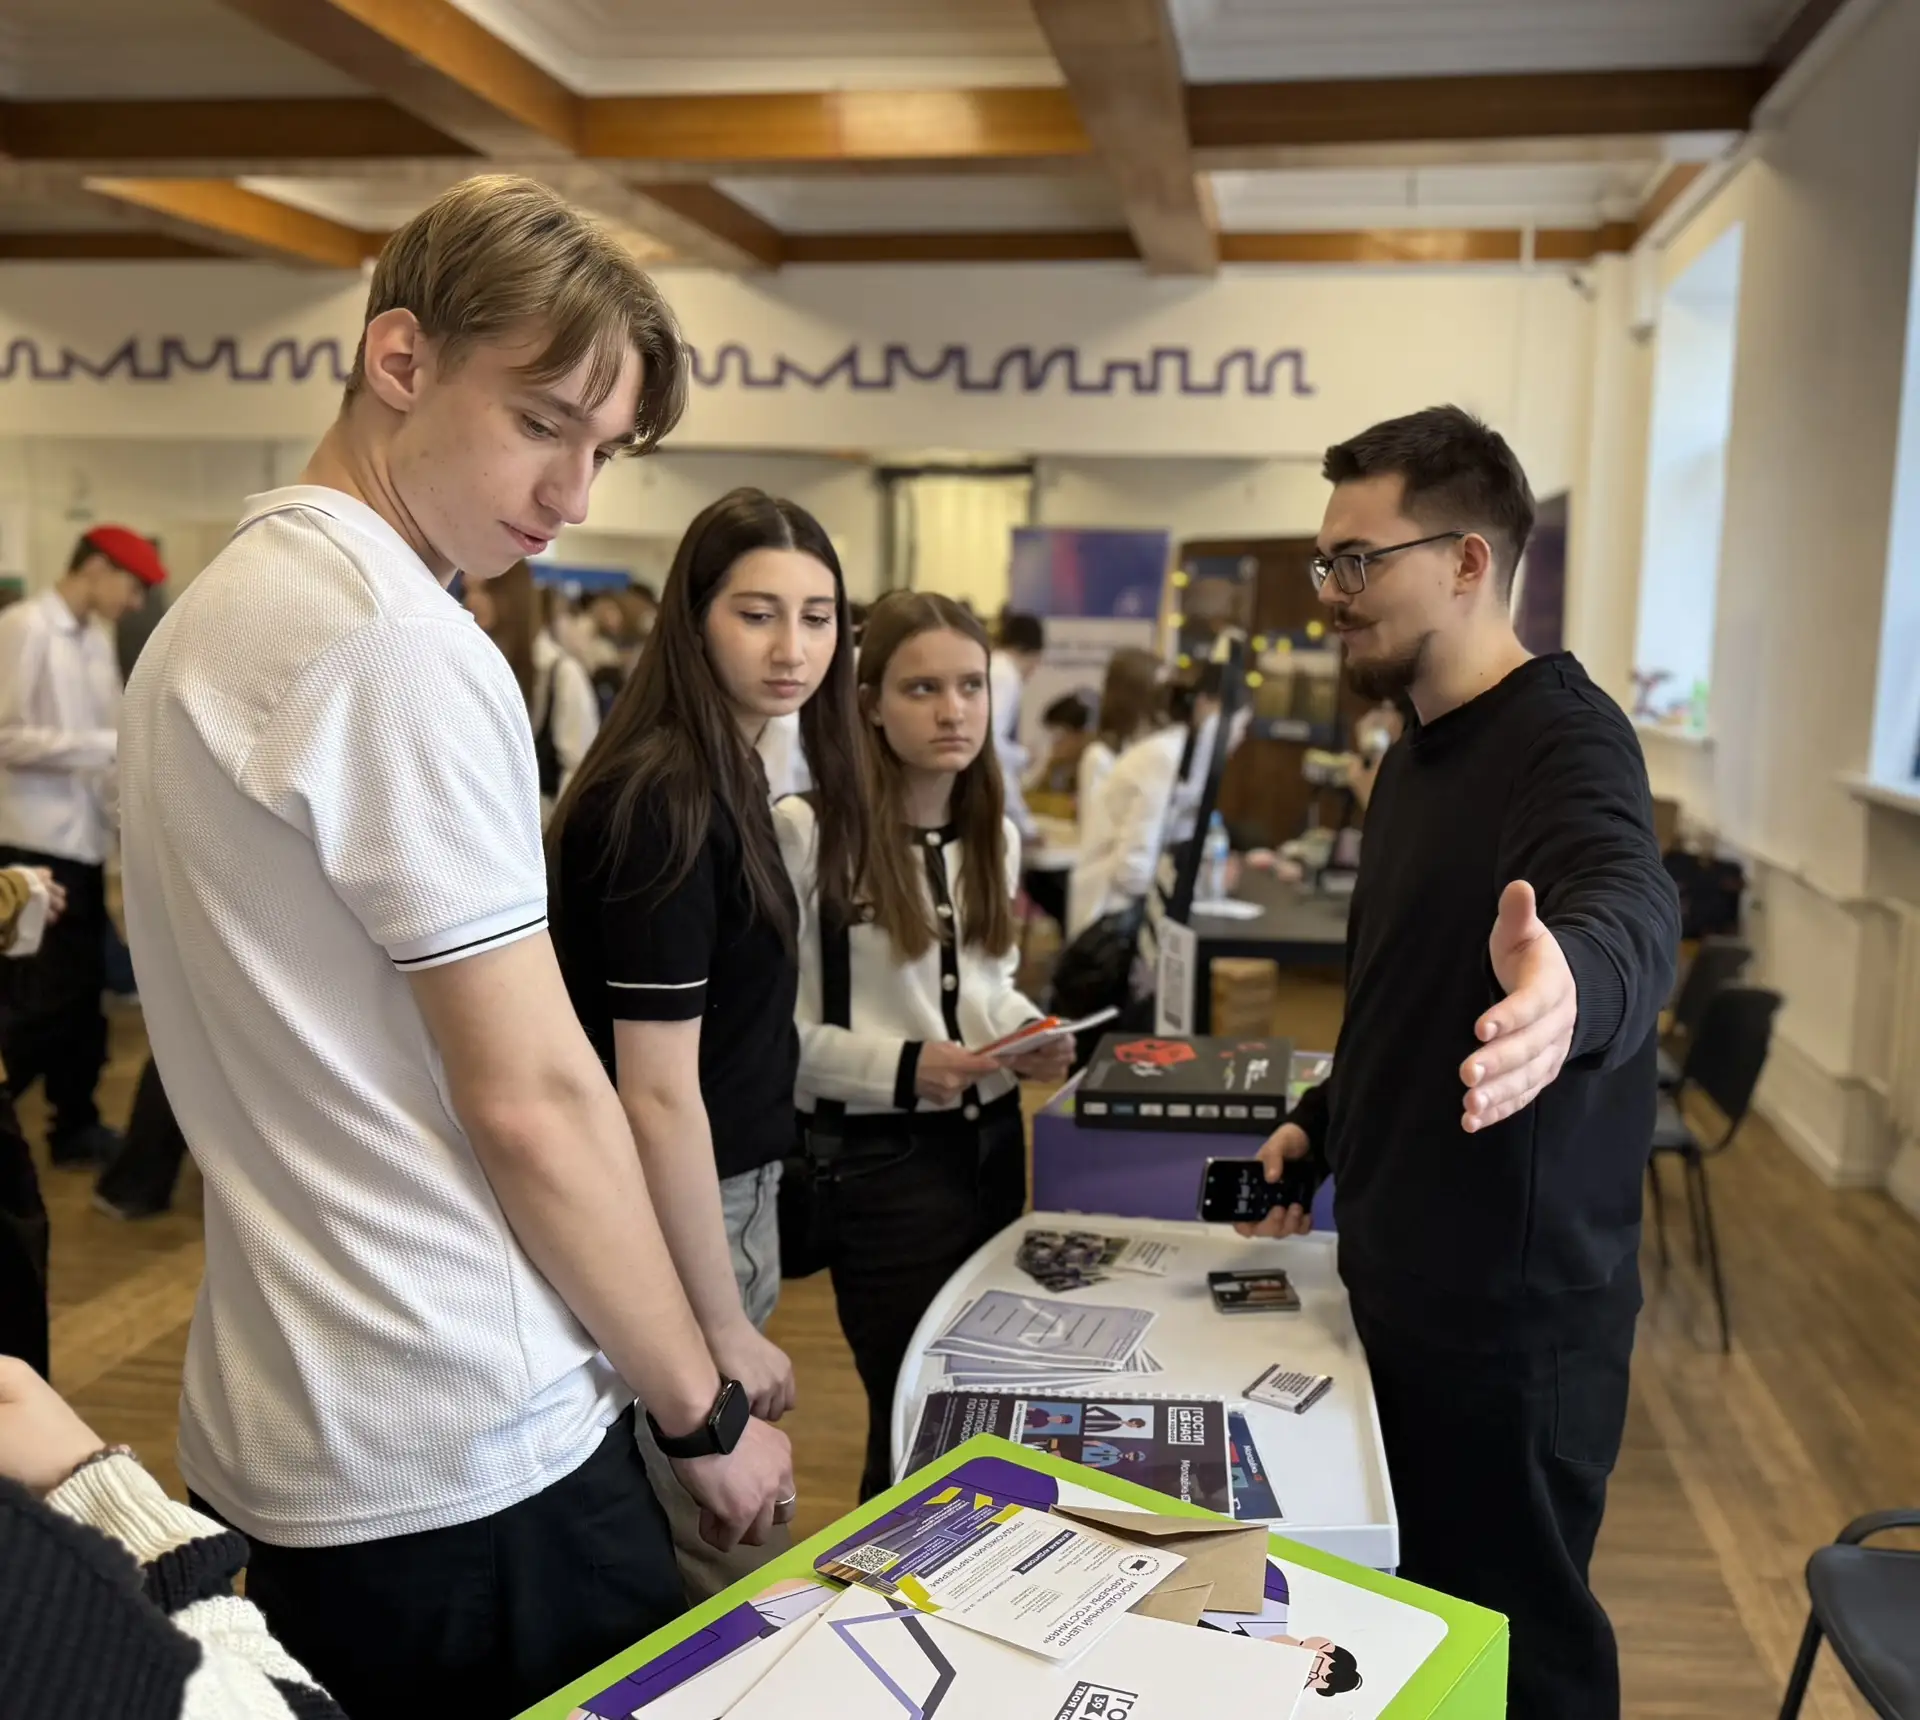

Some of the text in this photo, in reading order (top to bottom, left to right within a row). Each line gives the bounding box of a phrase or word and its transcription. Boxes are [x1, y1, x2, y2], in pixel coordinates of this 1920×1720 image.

[1180, 1423, 1191, 1442] НАЯ
[1192, 1410, 1204, 1443] ГОСТИ
[973, 1521, 1025, 1558] ПРЕДЛОЖЕНИЯ
[1080, 1580, 1138, 1626] МОЛОДЕЖНЫЙ
[1089, 1577, 1127, 1606] КАРЬЕРЫ
[1043, 1605, 1092, 1644] «ГОСТИНАЯ»
[1058, 1624, 1085, 1647] ЦЕНТР
[1068, 1685, 1088, 1708] ТВОЯ
[1091, 1696, 1106, 1709] 39
